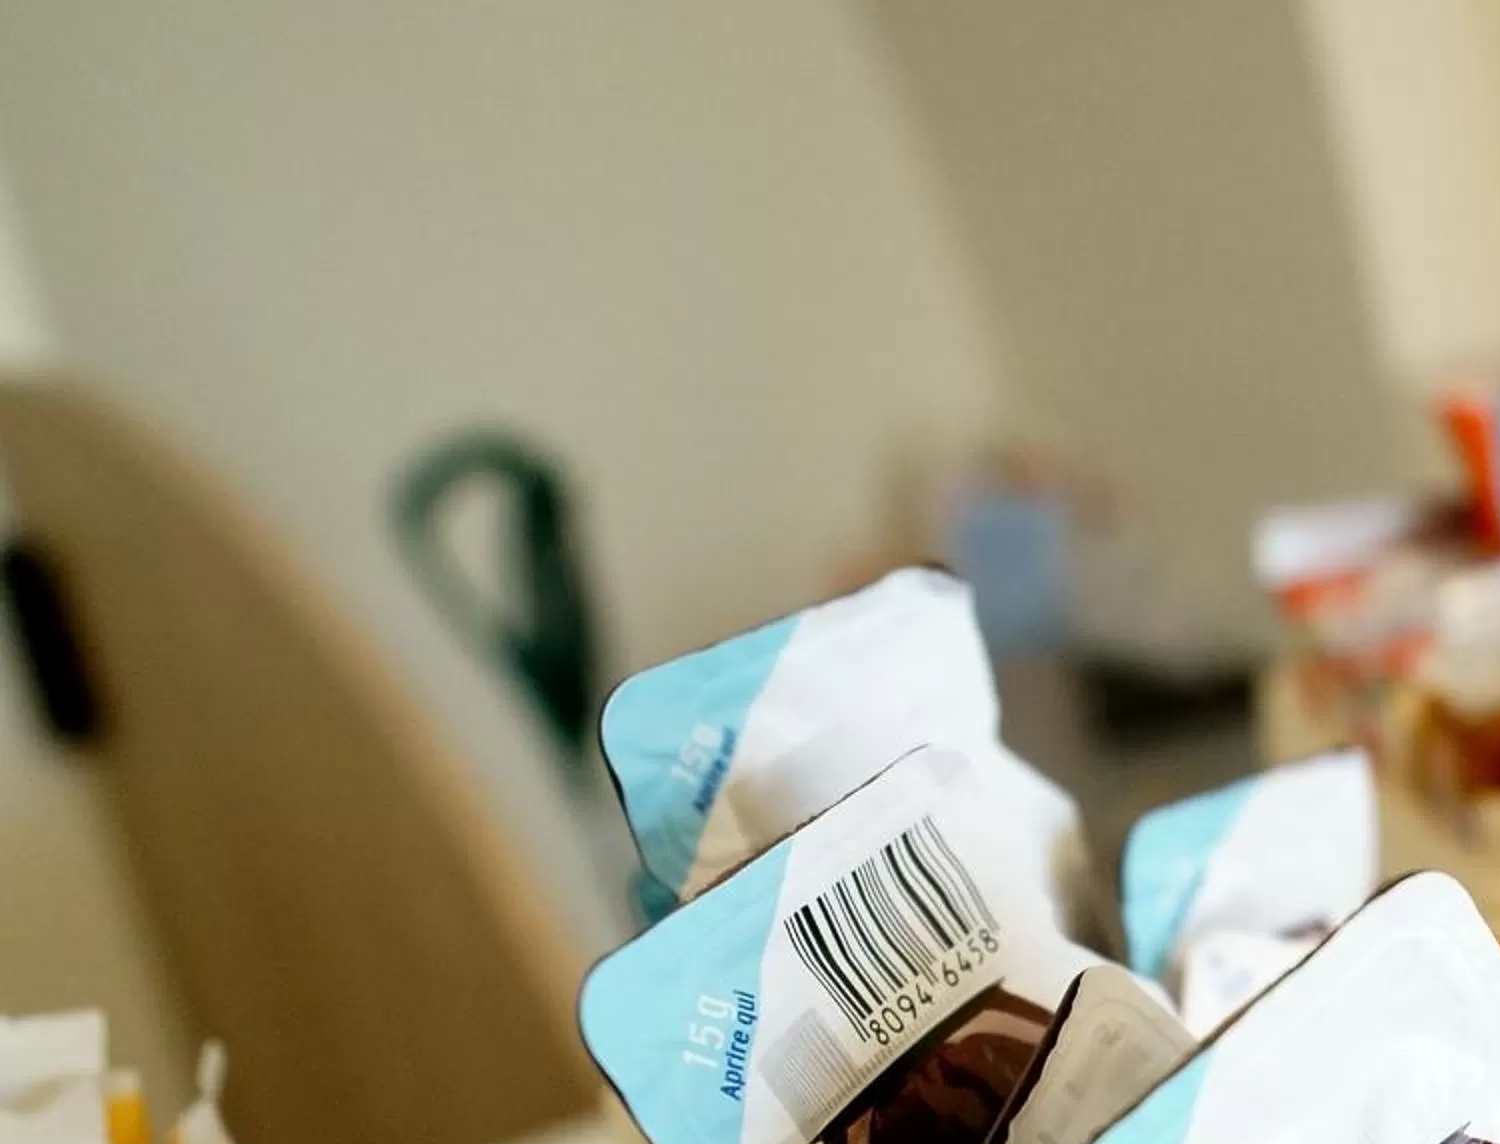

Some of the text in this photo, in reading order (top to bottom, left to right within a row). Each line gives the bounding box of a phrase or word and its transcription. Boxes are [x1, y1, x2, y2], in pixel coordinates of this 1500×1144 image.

[869, 928, 999, 1046] 8094 6458
[719, 989, 758, 1101] Aprire qui
